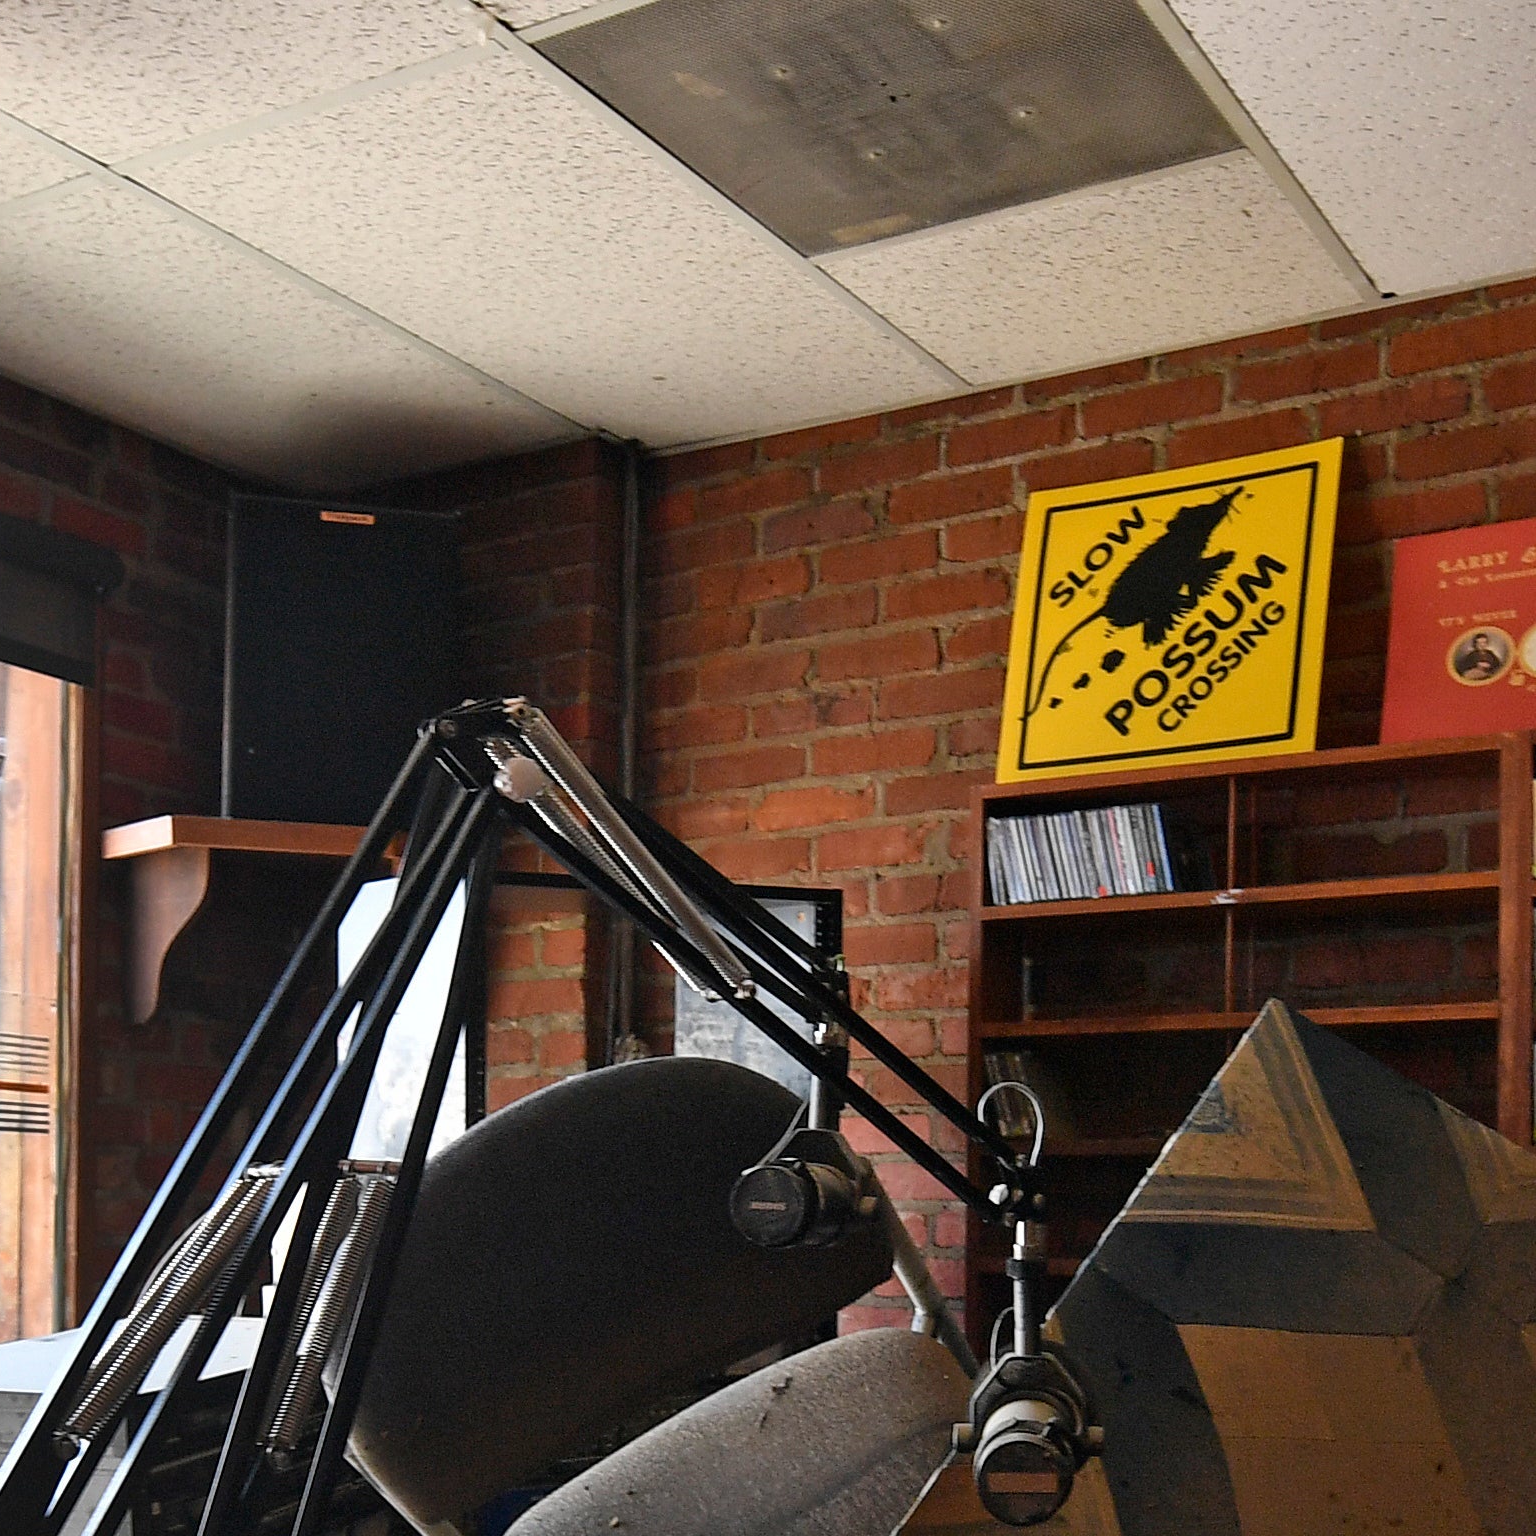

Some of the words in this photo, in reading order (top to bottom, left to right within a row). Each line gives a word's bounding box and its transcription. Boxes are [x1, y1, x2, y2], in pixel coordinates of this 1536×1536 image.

[1049, 503, 1145, 609] SLOW
[1104, 553, 1288, 738] POSSUM
[1157, 600, 1286, 733] CROSSING
